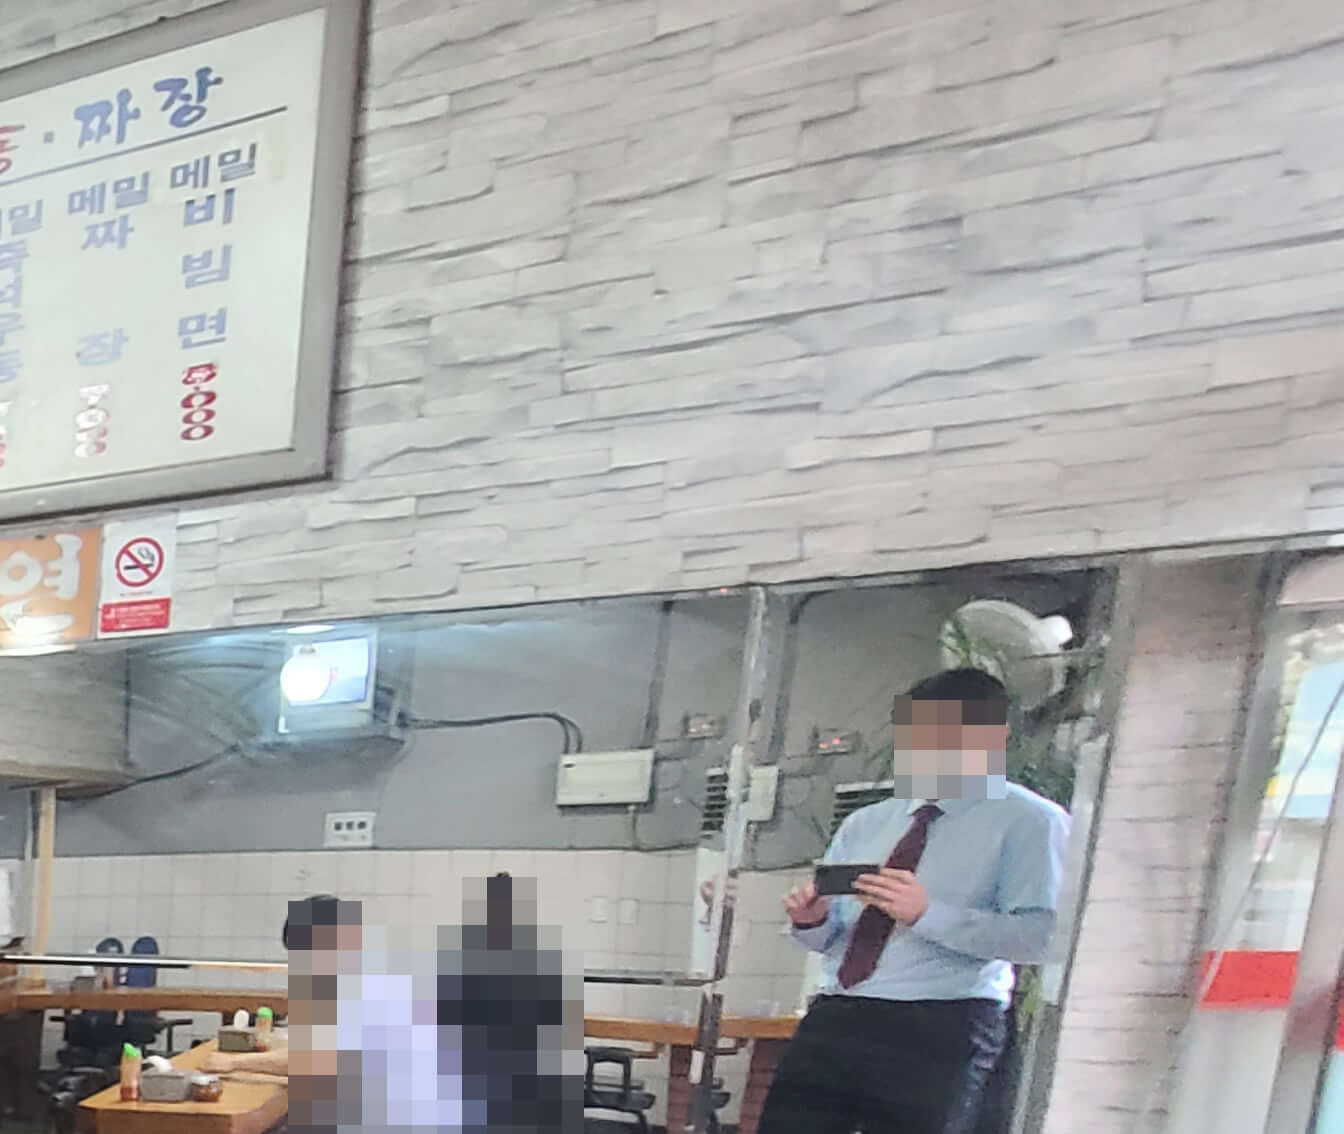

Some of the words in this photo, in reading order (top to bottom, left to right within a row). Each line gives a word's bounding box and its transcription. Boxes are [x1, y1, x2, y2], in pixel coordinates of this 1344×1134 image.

[75, 66, 224, 150] 짜장
[67, 171, 150, 216] 메밀
[169, 142, 257, 190] 메밀
[177, 187, 237, 350] 비빔면
